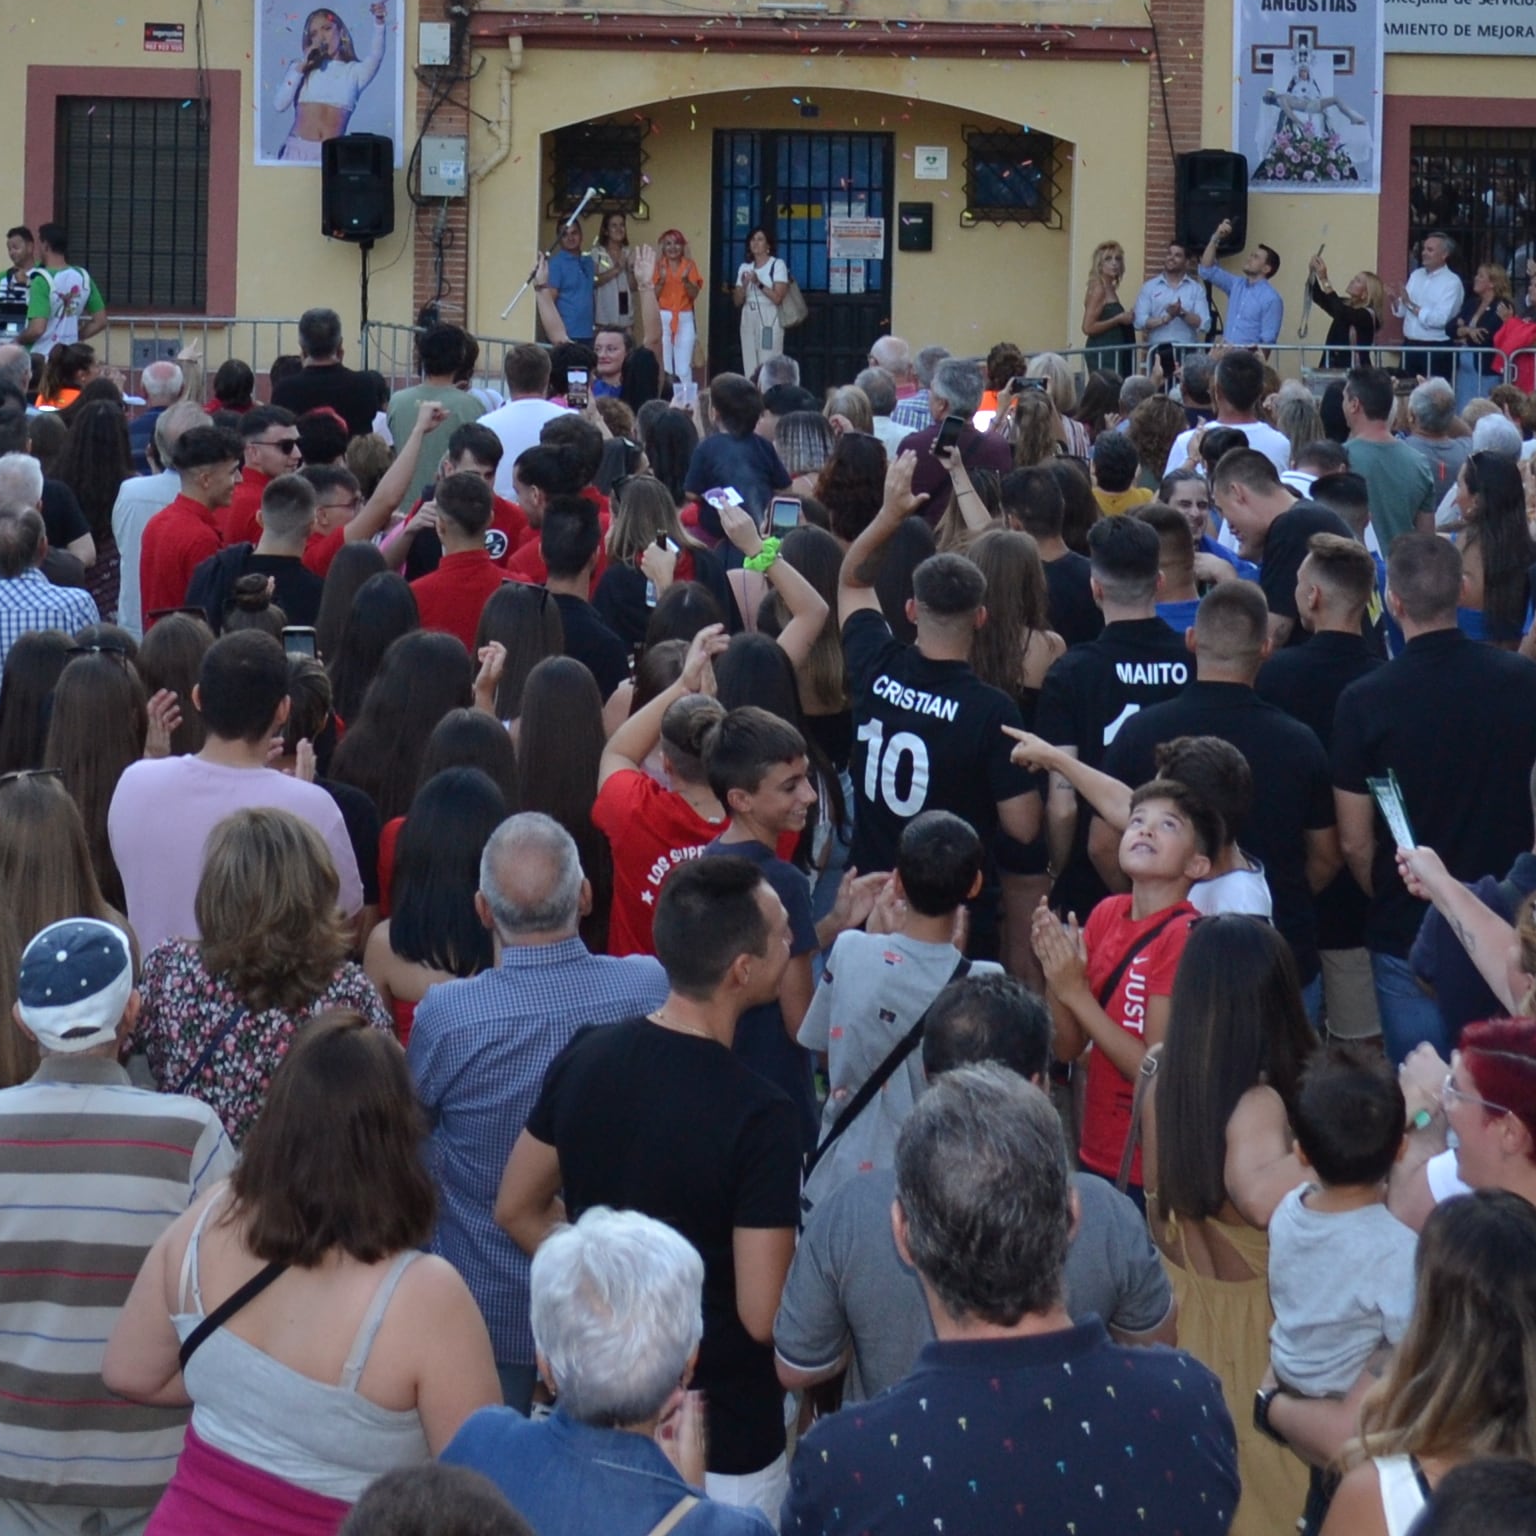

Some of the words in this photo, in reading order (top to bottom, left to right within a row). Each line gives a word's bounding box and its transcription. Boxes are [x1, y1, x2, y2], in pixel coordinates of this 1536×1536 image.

[1384, 23, 1448, 36] AMIENTO
[1454, 24, 1472, 37] DE
[872, 674, 959, 722] CRISTIAN
[857, 717, 929, 817] 10
[647, 856, 670, 885] LOS
[1122, 968, 1146, 1034] JUST
